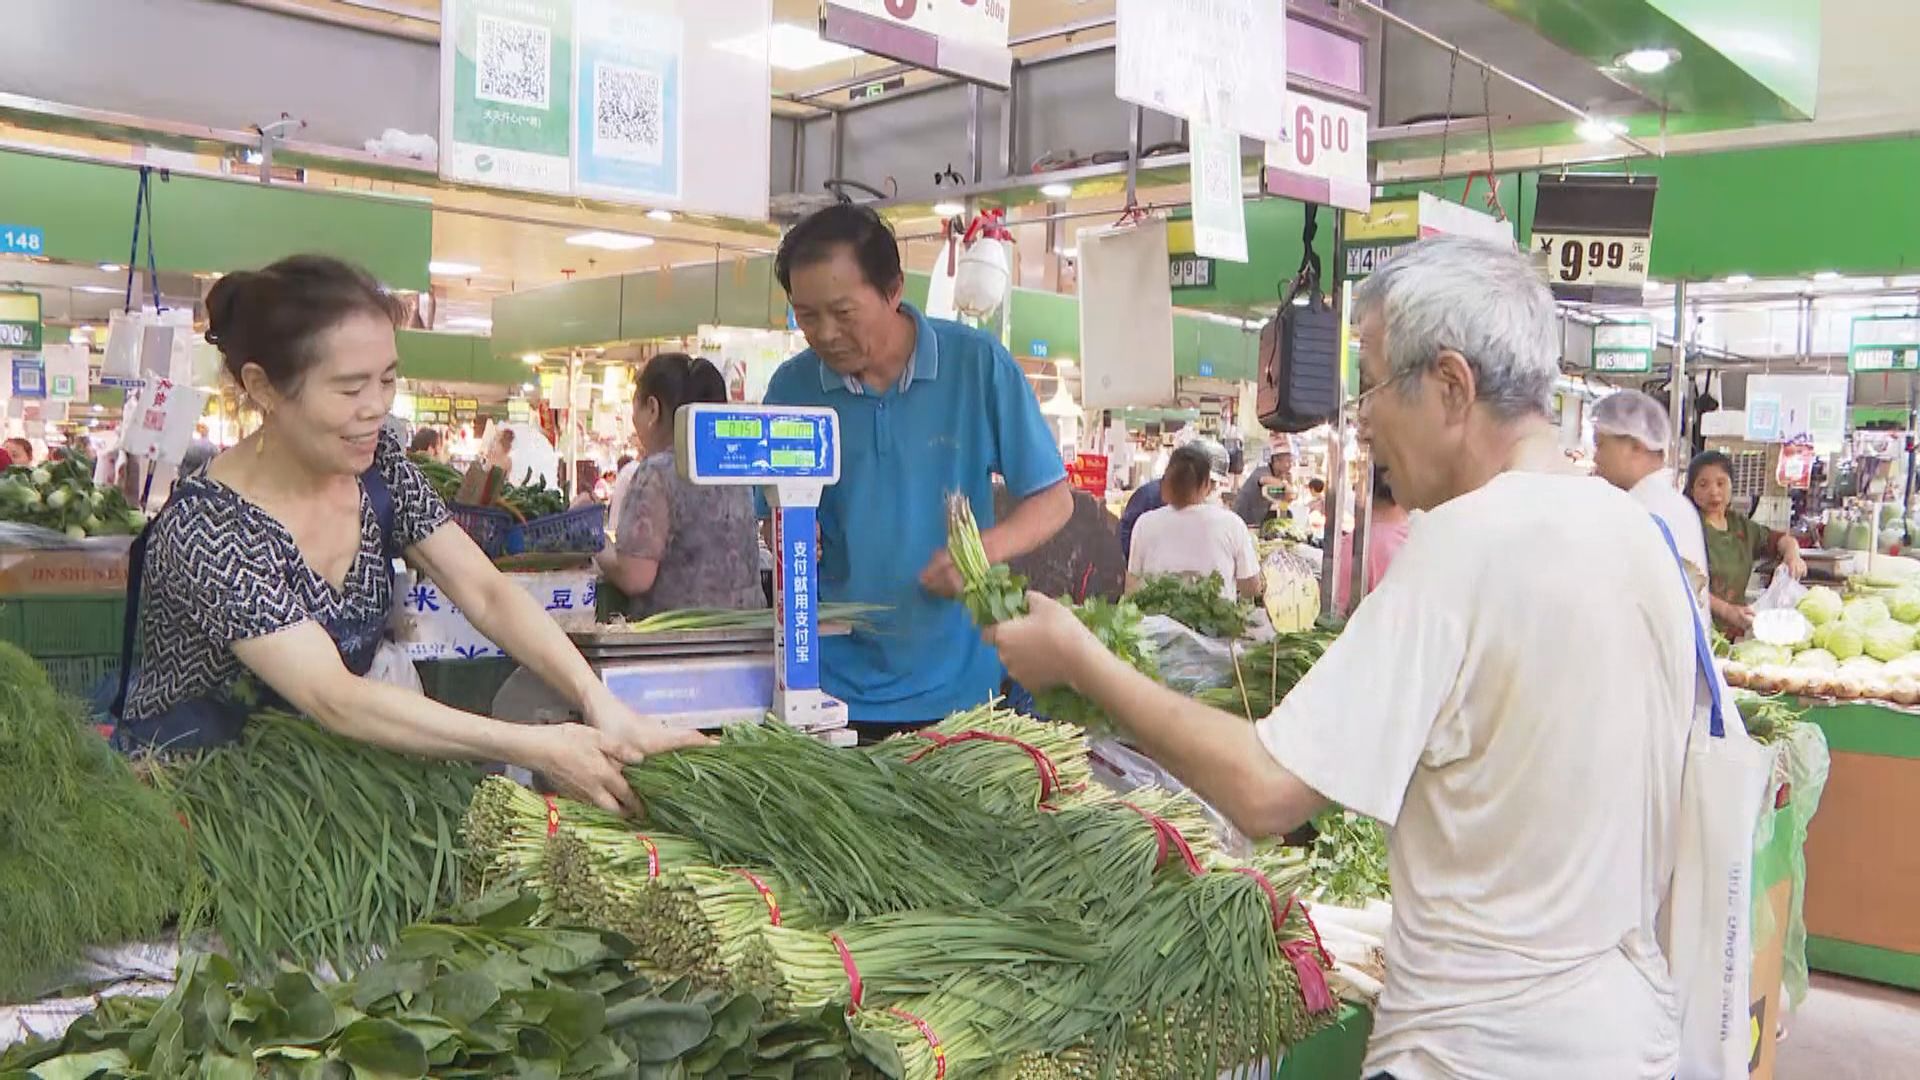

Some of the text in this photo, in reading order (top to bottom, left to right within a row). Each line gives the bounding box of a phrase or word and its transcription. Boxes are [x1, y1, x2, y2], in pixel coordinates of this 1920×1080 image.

[5, 231, 40, 250] 148
[793, 541, 809, 663] 支付就用支付宝
